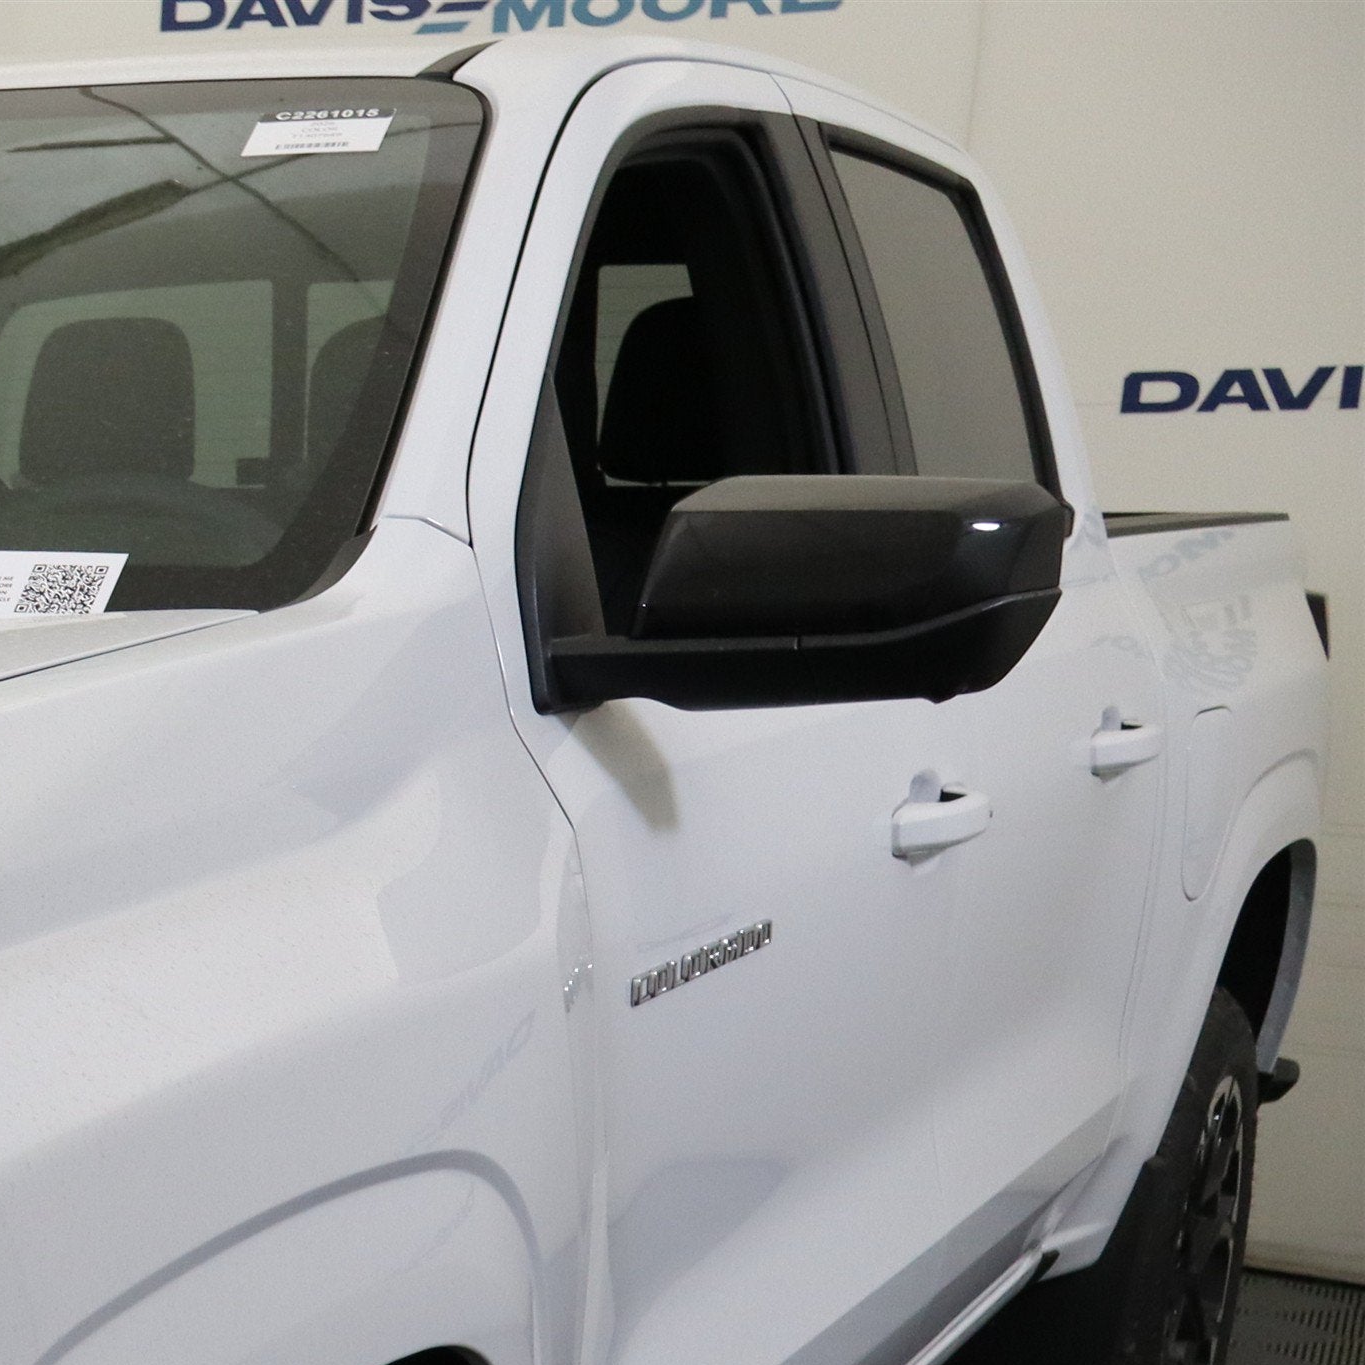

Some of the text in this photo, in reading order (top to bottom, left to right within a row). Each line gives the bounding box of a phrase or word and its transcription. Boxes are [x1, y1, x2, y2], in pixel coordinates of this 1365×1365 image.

[160, 0, 431, 32] DAVIS
[275, 108, 380, 121] C2261015
[1120, 365, 1365, 413] DAVI
